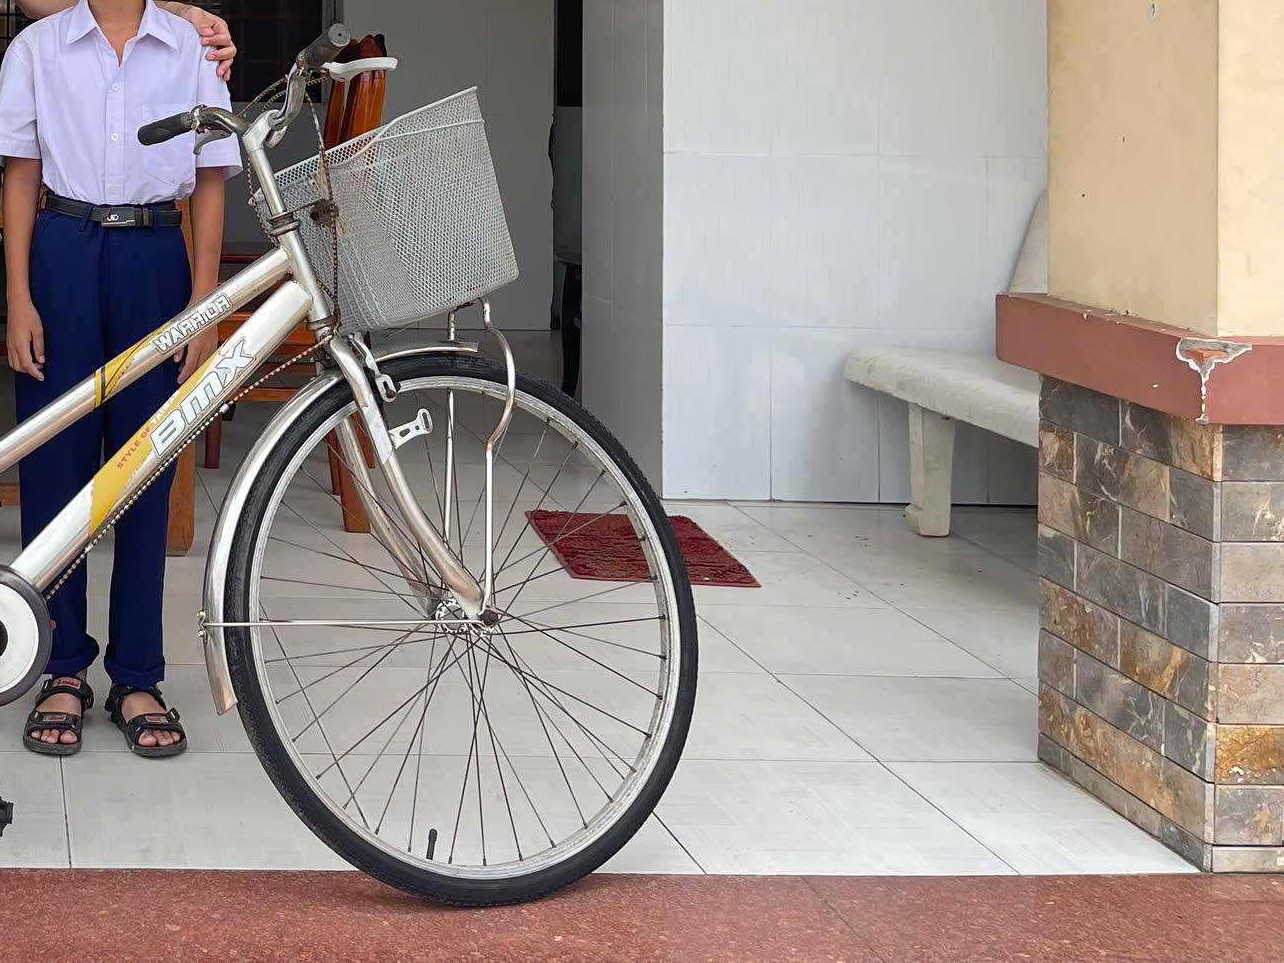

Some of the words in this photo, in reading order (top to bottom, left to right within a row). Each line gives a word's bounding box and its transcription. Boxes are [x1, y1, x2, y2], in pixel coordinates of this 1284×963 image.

[153, 294, 231, 353] WARRIOR
[117, 440, 140, 469] STYLE
[141, 426, 151, 438] OF
[150, 390, 180, 424] TAIWAN
